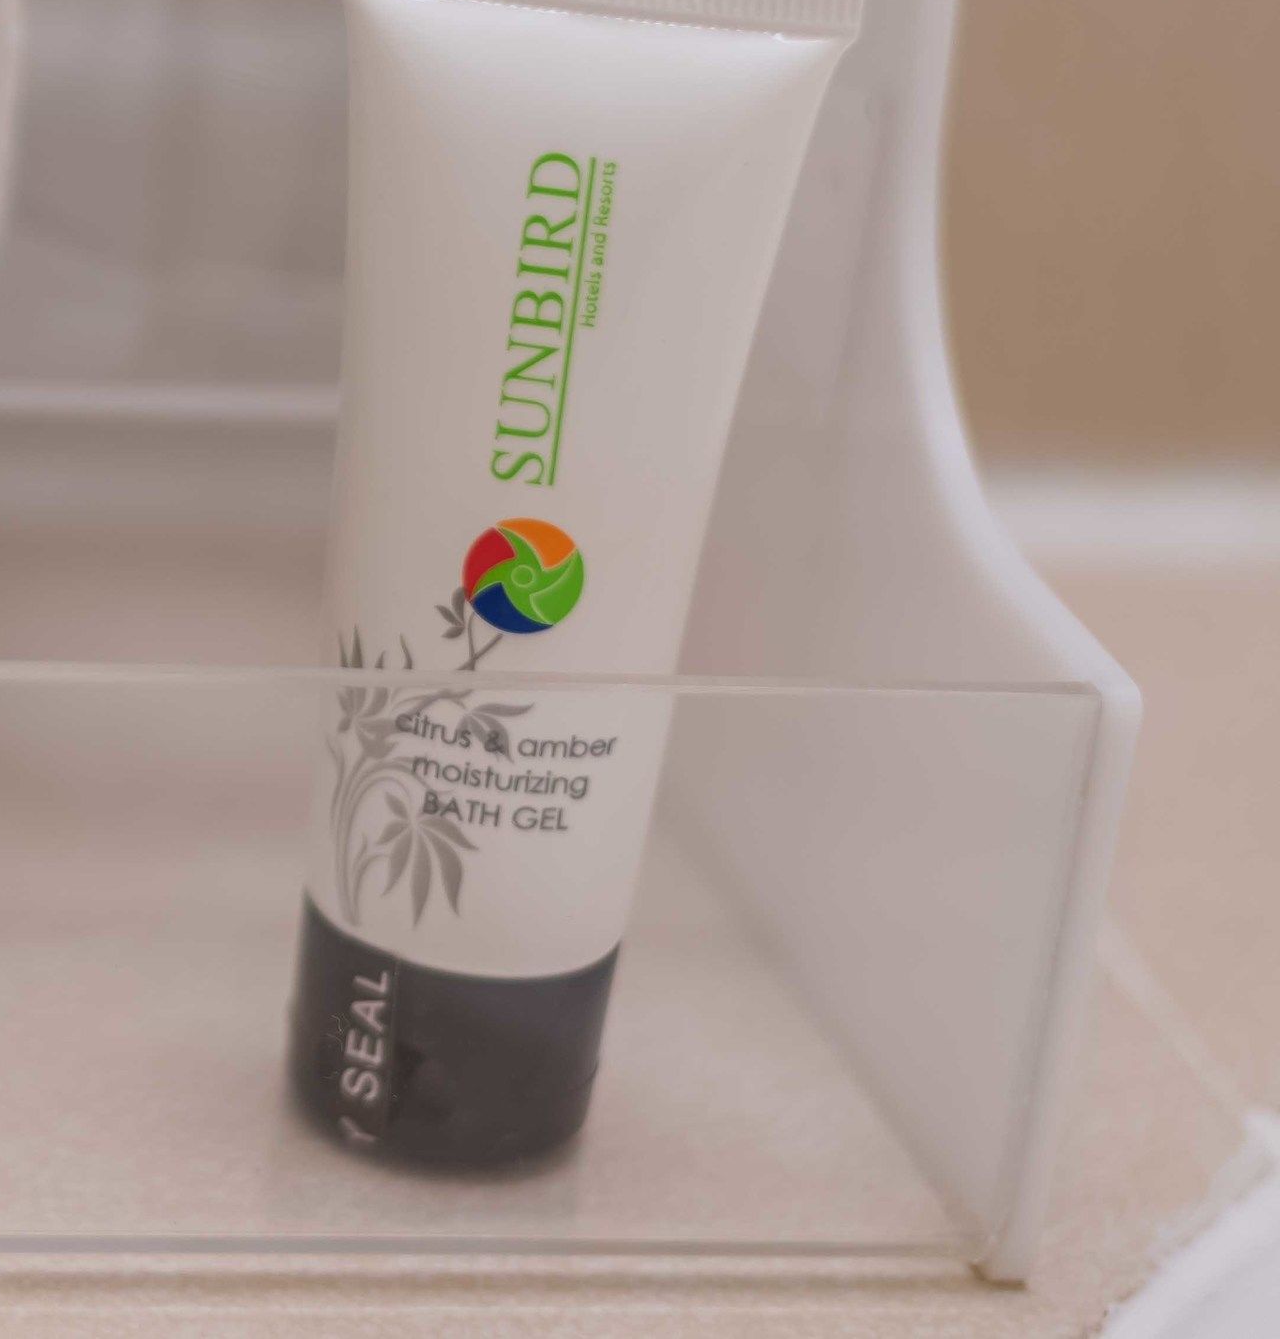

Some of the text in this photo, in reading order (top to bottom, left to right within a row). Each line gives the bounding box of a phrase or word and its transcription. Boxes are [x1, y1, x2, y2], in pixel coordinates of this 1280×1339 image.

[579, 160, 617, 328] Hotels and Resorts
[489, 151, 582, 486] SUNBIRD
[394, 708, 619, 759] citrus & amber
[410, 756, 589, 800] moisturizing
[422, 791, 569, 832] BATH GEL
[341, 969, 392, 1103] SEAL
